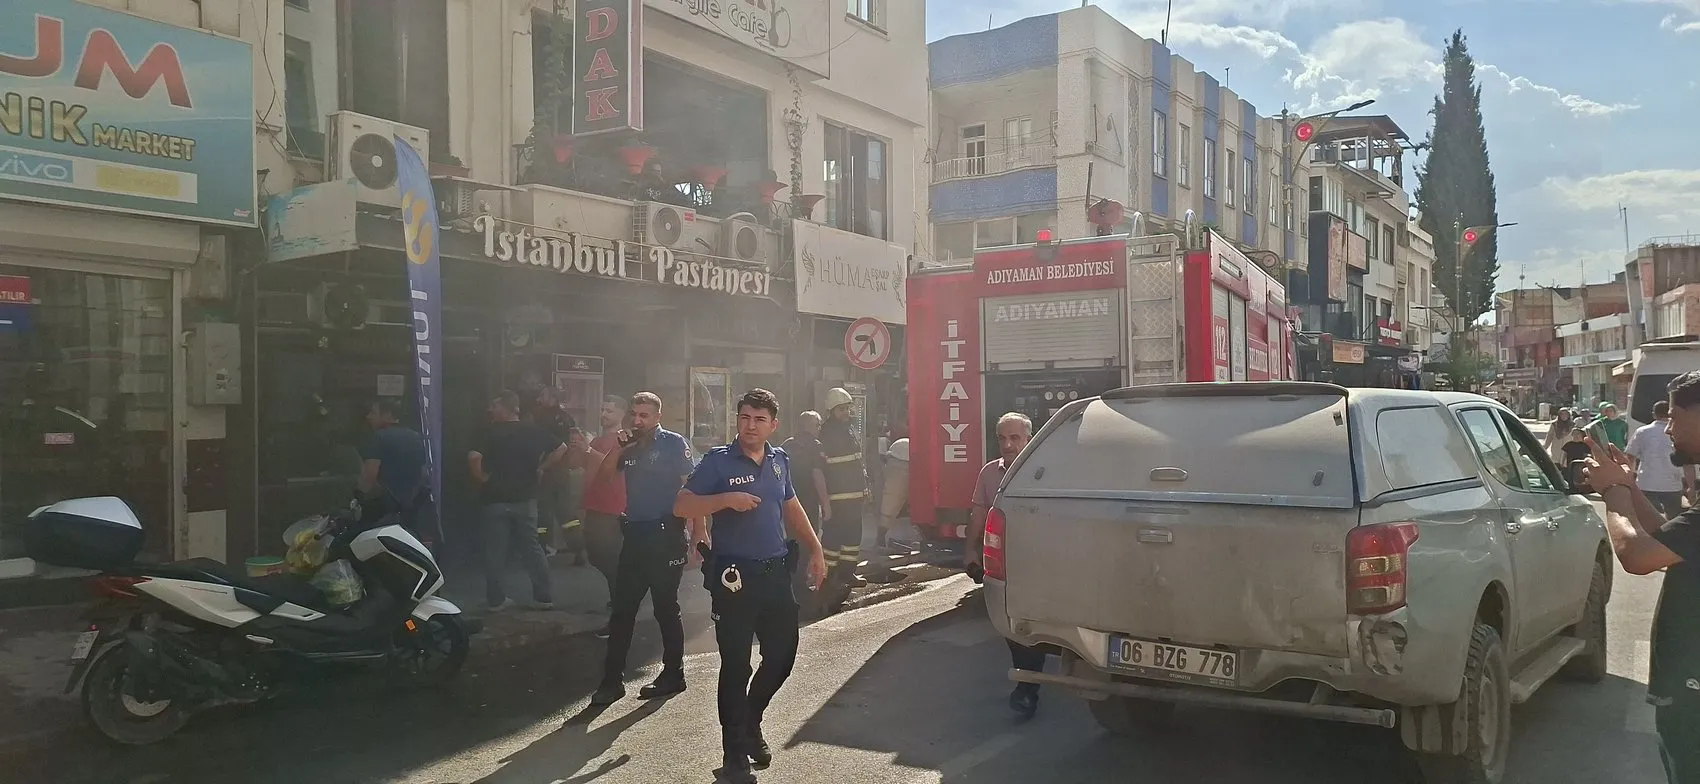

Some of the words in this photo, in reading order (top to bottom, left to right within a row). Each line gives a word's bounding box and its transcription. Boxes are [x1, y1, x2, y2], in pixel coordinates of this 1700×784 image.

[727, 3, 768, 37] Cafe
[583, 0, 620, 121] DAK
[92, 123, 196, 161] MARKET
[650, 246, 771, 296] Pastanesi
[820, 255, 874, 291] HÜMA
[987, 266, 1044, 285] ADIYAMAN
[1046, 256, 1115, 280] BELEDİYESİ
[0, 290, 25, 300] TILIR
[994, 298, 1109, 322] ADIYAMAN
[1215, 324, 1227, 361] 112
[940, 320, 970, 463] İTFAİYE
[729, 474, 755, 486] POLIS
[1121, 640, 1143, 664] 06
[1153, 644, 1187, 670] BZG
[1199, 650, 1234, 677] 778
